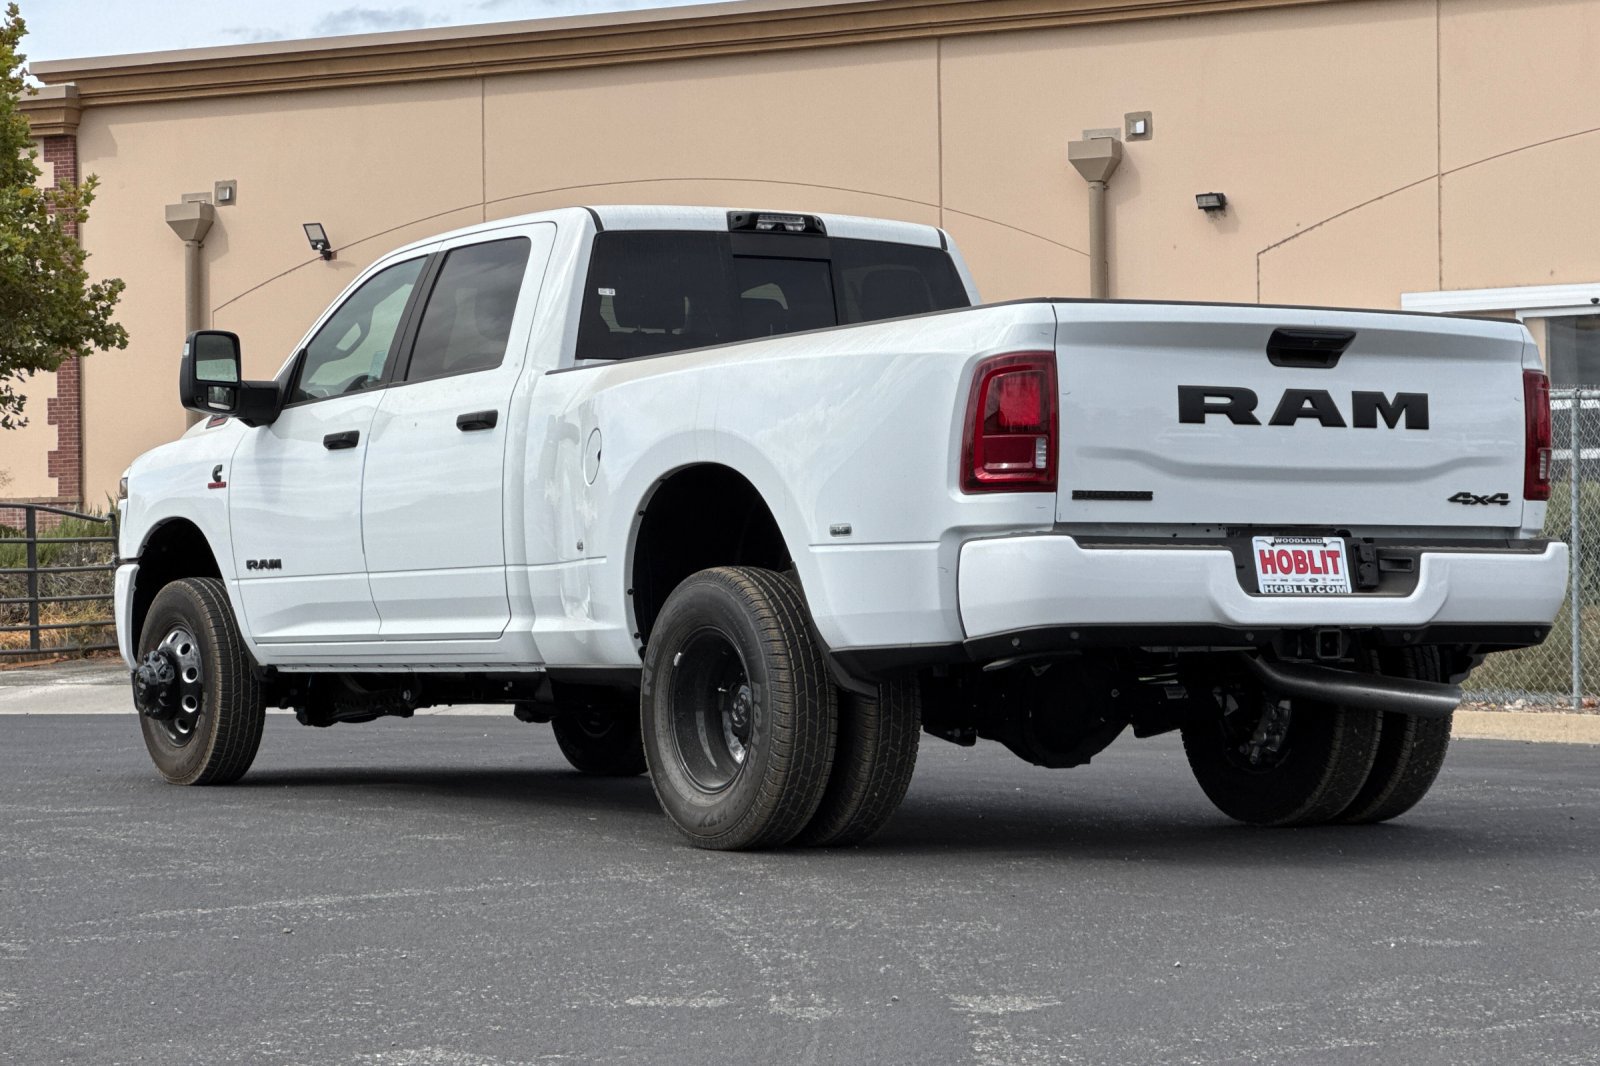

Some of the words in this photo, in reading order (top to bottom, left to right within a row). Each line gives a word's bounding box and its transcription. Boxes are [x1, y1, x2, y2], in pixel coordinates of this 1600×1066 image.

[1178, 385, 1430, 430] RAM
[1446, 491, 1511, 505] 4x4
[245, 558, 283, 571] RAM
[1259, 549, 1340, 575] HOBLIT
[1263, 585, 1347, 593] HOBLIT.COM
